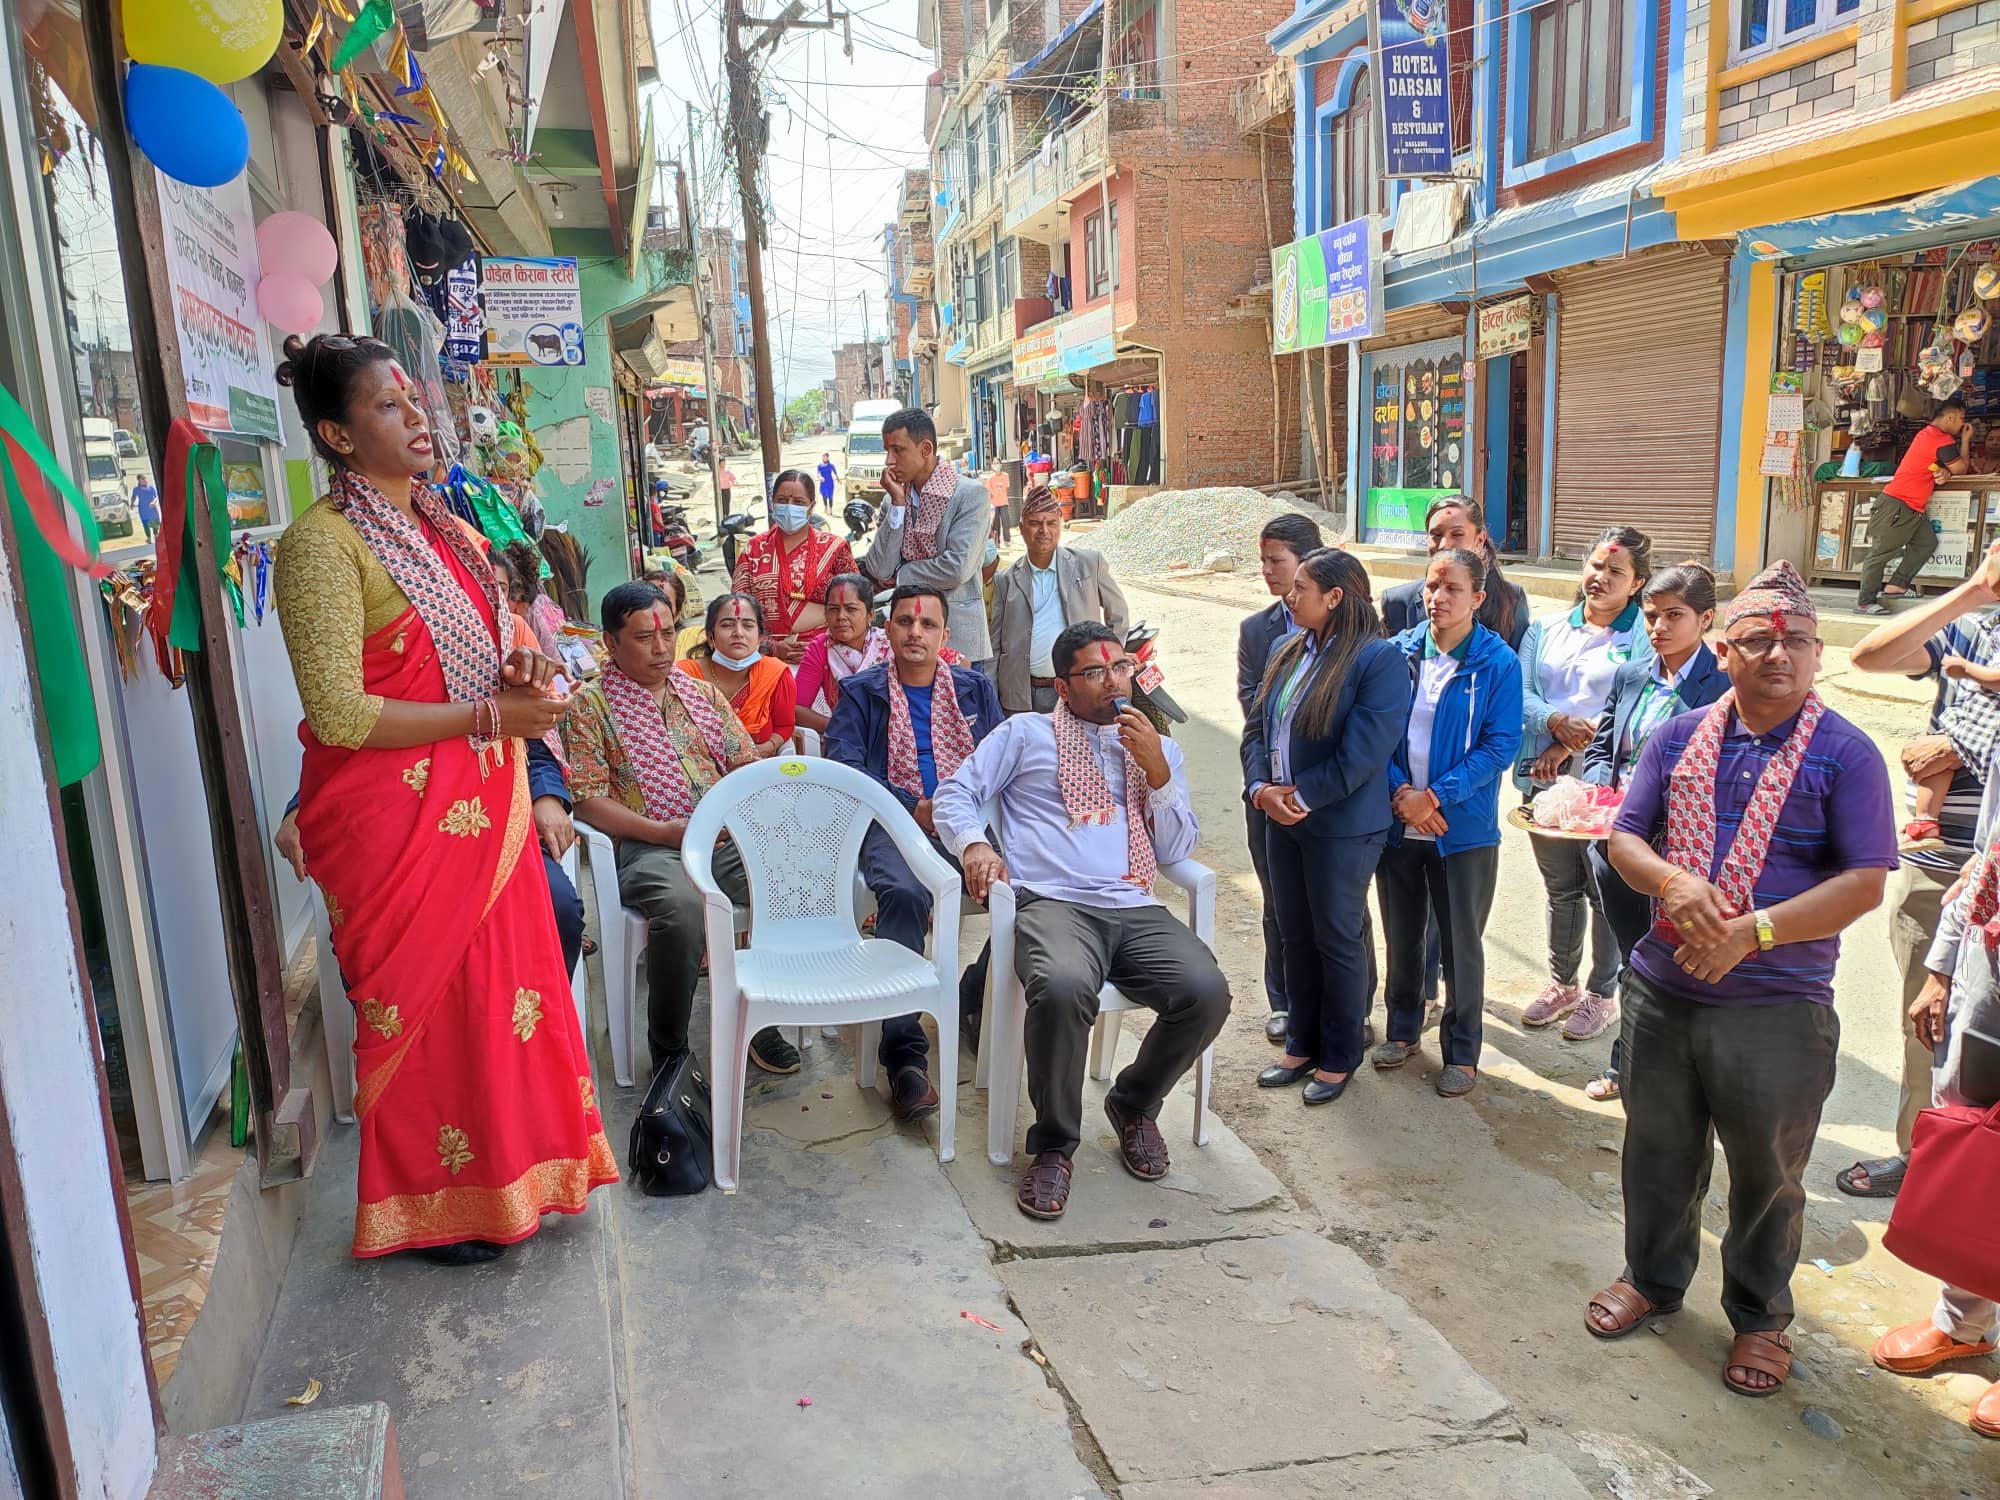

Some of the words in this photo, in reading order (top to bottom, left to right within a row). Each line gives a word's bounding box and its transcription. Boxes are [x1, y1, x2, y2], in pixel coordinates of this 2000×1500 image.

[1392, 55, 1437, 74] HOTEL
[1389, 78, 1442, 97] DARSAN
[1412, 100, 1421, 119] &
[1392, 122, 1445, 135] RESTURANT
[514, 264, 547, 283] किराना
[1481, 310, 1504, 332] होटल
[1375, 402, 1399, 423] दर्शन
